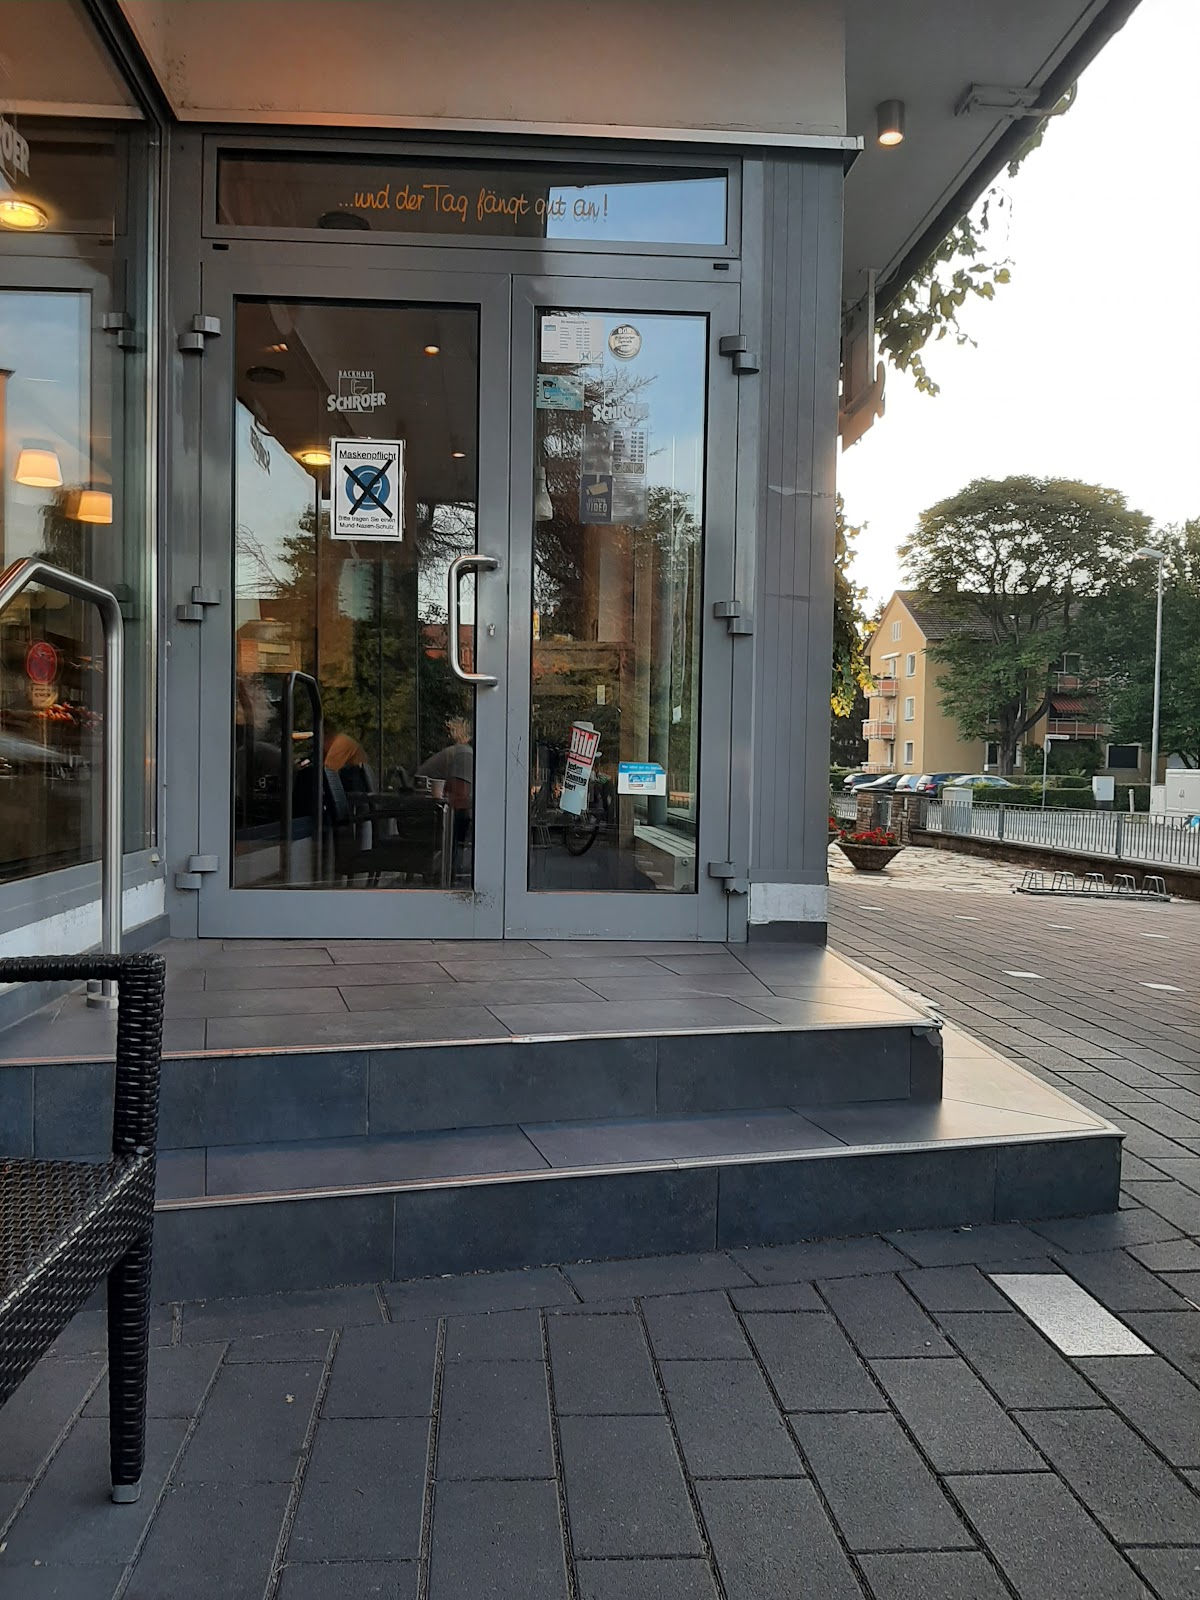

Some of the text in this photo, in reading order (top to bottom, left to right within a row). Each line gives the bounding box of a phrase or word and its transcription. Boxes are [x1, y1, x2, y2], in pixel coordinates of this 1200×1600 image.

[395, 184, 424, 211] der
[423, 184, 468, 223] Tag
[477, 188, 530, 224] fängt
[535, 195, 566, 224] gut
[573, 193, 609, 217] an!
[338, 370, 375, 378] BACKHAUS
[339, 450, 397, 461] Maskenpflicht
[586, 502, 608, 513] VIDEO
[339, 522, 394, 530] Mund-Nasen-Schutz
[570, 728, 598, 758] Bild
